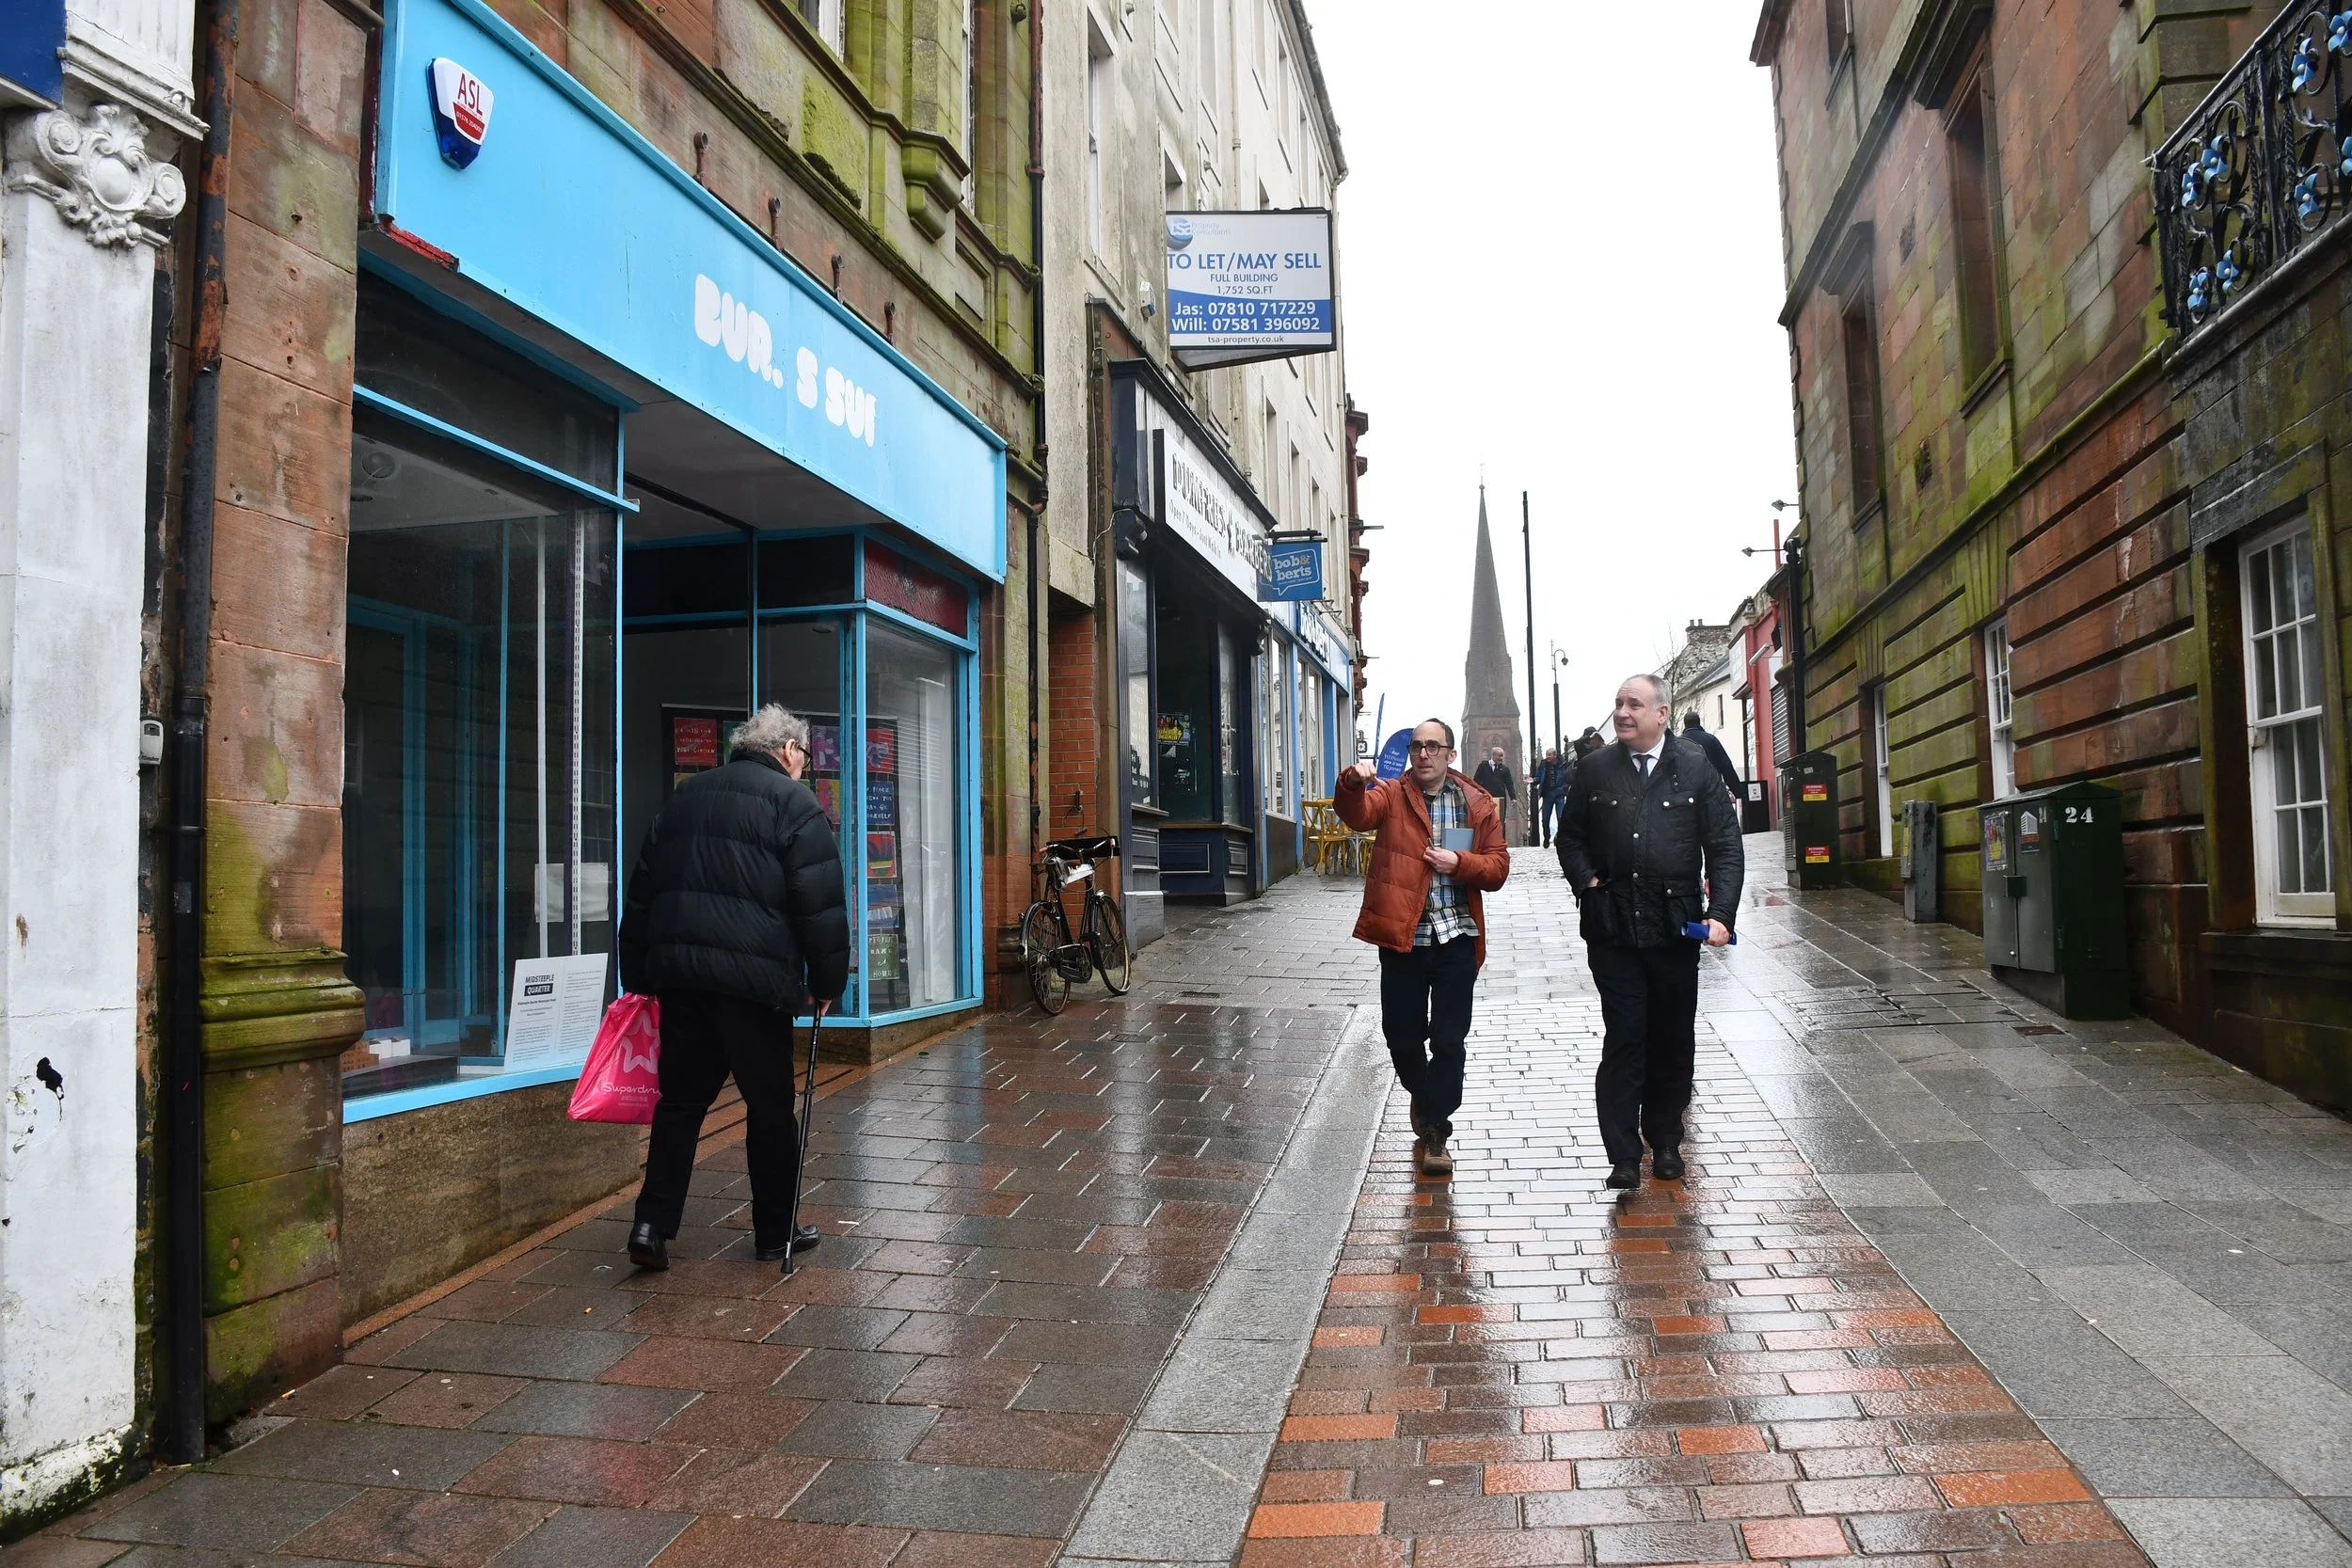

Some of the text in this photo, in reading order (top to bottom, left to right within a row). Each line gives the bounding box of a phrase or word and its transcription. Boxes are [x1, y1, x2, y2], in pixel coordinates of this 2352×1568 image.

[457, 72, 483, 116] ASL
[1167, 252, 1321, 273] TO LET/MAY SELL
[1210, 273, 1279, 282] FULL BUILDING
[1216, 285, 1273, 295] 1,752 SQ.FT
[1175, 301, 1316, 316] Jas: 07810 717229
[1171, 317, 1320, 332] Will: 07581 396092
[1207, 335, 1284, 344] tsa-property.co.uk
[796, 346, 818, 409] S
[1276, 566, 1312, 581] berts
[2064, 806, 2094, 824] 24
[525, 974, 555, 984] MIDSTEEPLE
[527, 984, 551, 995] QUARTER
[602, 1082, 662, 1096] Superdru
